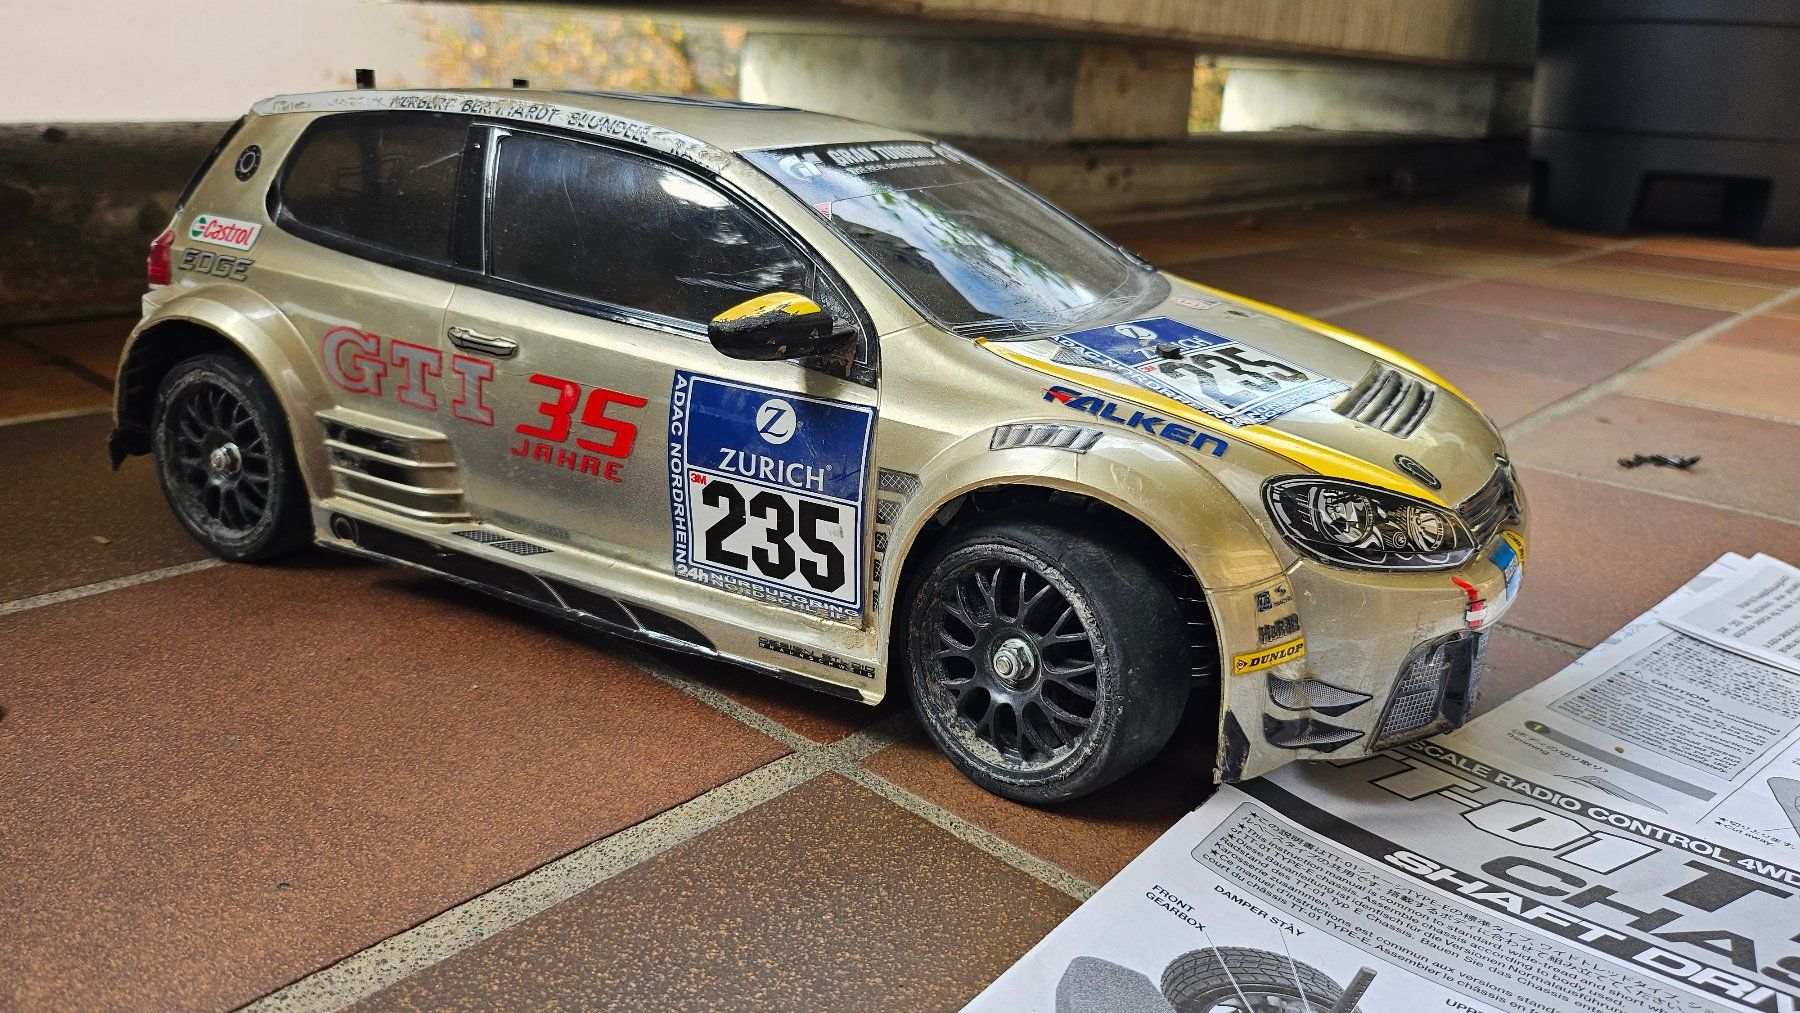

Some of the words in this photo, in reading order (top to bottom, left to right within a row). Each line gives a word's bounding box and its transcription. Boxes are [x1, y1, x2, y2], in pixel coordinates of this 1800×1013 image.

[826, 146, 880, 167] GRAN
[178, 247, 256, 282] EDGE
[203, 219, 256, 246] Castrol
[321, 325, 494, 426] GTI
[671, 373, 688, 436] ADAC
[1158, 346, 1310, 409] 235
[515, 373, 648, 459] 35
[1042, 385, 1229, 457] FALKEN
[510, 438, 625, 484] JAHRE
[690, 472, 707, 486] 3M
[670, 442, 687, 566] NORDRHEIN
[701, 478, 846, 593] 235
[677, 563, 707, 582] 24h
[1249, 642, 1304, 667] DUNLOP
[1651, 679, 1710, 702] CAUTION
[1494, 772, 1582, 811] RADIO
[1587, 807, 1730, 862] CONTROL
[1152, 884, 1196, 912] FRONT
[1214, 841, 1269, 877] Karosserie
[1270, 876, 1331, 909] zusammen.
[1383, 850, 1628, 942] SHAFT
[1145, 891, 1206, 932] GEARBOX
[1202, 853, 1232, 873] court
[1231, 871, 1245, 882] du
[1246, 879, 1288, 905] châssis
[1290, 903, 1321, 921] TT-01
[1324, 920, 1372, 947] TYPE-E.
[1374, 944, 1441, 976] Assembler
[1442, 973, 1454, 981] le
[1457, 979, 1506, 1004] châssis
[1509, 1001, 1526, 1012] en
[1213, 884, 1268, 919] DAMPER
[1269, 916, 1305, 937] STAY
[1219, 837, 1269, 868] Radstand
[1271, 868, 1291, 881] des
[1295, 879, 1326, 897] TT-01
[1331, 896, 1350, 909] Typ
[1366, 913, 1415, 940] Chassis.
[1420, 937, 1459, 958] Bauen
[1463, 955, 1484, 968] Sie
[1488, 965, 1512, 979] das
[1516, 976, 1569, 1002] Chassis
[1219, 854, 1234, 865] Ce
[1235, 865, 1275, 889] manuel
[1276, 887, 1352, 927] d'instructions
[1354, 926, 1374, 937] est
[1376, 936, 1429, 962] commun
[1431, 961, 1456, 974] aux
[1459, 971, 1514, 997] versions
[1230, 827, 1243, 835] of
[1244, 834, 1271, 853] TT-01
[1273, 851, 1315, 875] TYPE-E
[1315, 874, 1358, 897] chassis.
[1362, 895, 1419, 924] Assemble
[1421, 922, 1468, 945] chassis
[1470, 942, 1533, 971] according
[1536, 968, 1549, 977] to
[1552, 973, 1585, 991] body
[1588, 989, 1625, 1008] used.
[1235, 838, 1264, 857] Diese
[1265, 855, 1335, 894] Bauanleitung
[1335, 890, 1351, 901] ist
[1351, 897, 1404, 926] identisch
[1405, 922, 1422, 933] für
[1423, 930, 1442, 942] die
[1445, 939, 1505, 968] Versionen
[1508, 964, 1628, 1013] Normalausführun
[1248, 828, 1267, 842] This
[1269, 841, 1323, 871] instruction
[1325, 871, 1366, 891] manual
[1368, 889, 1377, 897] is
[1379, 895, 1430, 920] common
[1432, 918, 1444, 927] to
[1446, 924, 1504, 952] standard,
[1508, 949, 1577, 980] wide-tread
[1579, 979, 1606, 991] and
[1609, 989, 1644, 1007] short
[1445, 998, 1484, 1013] UPP
